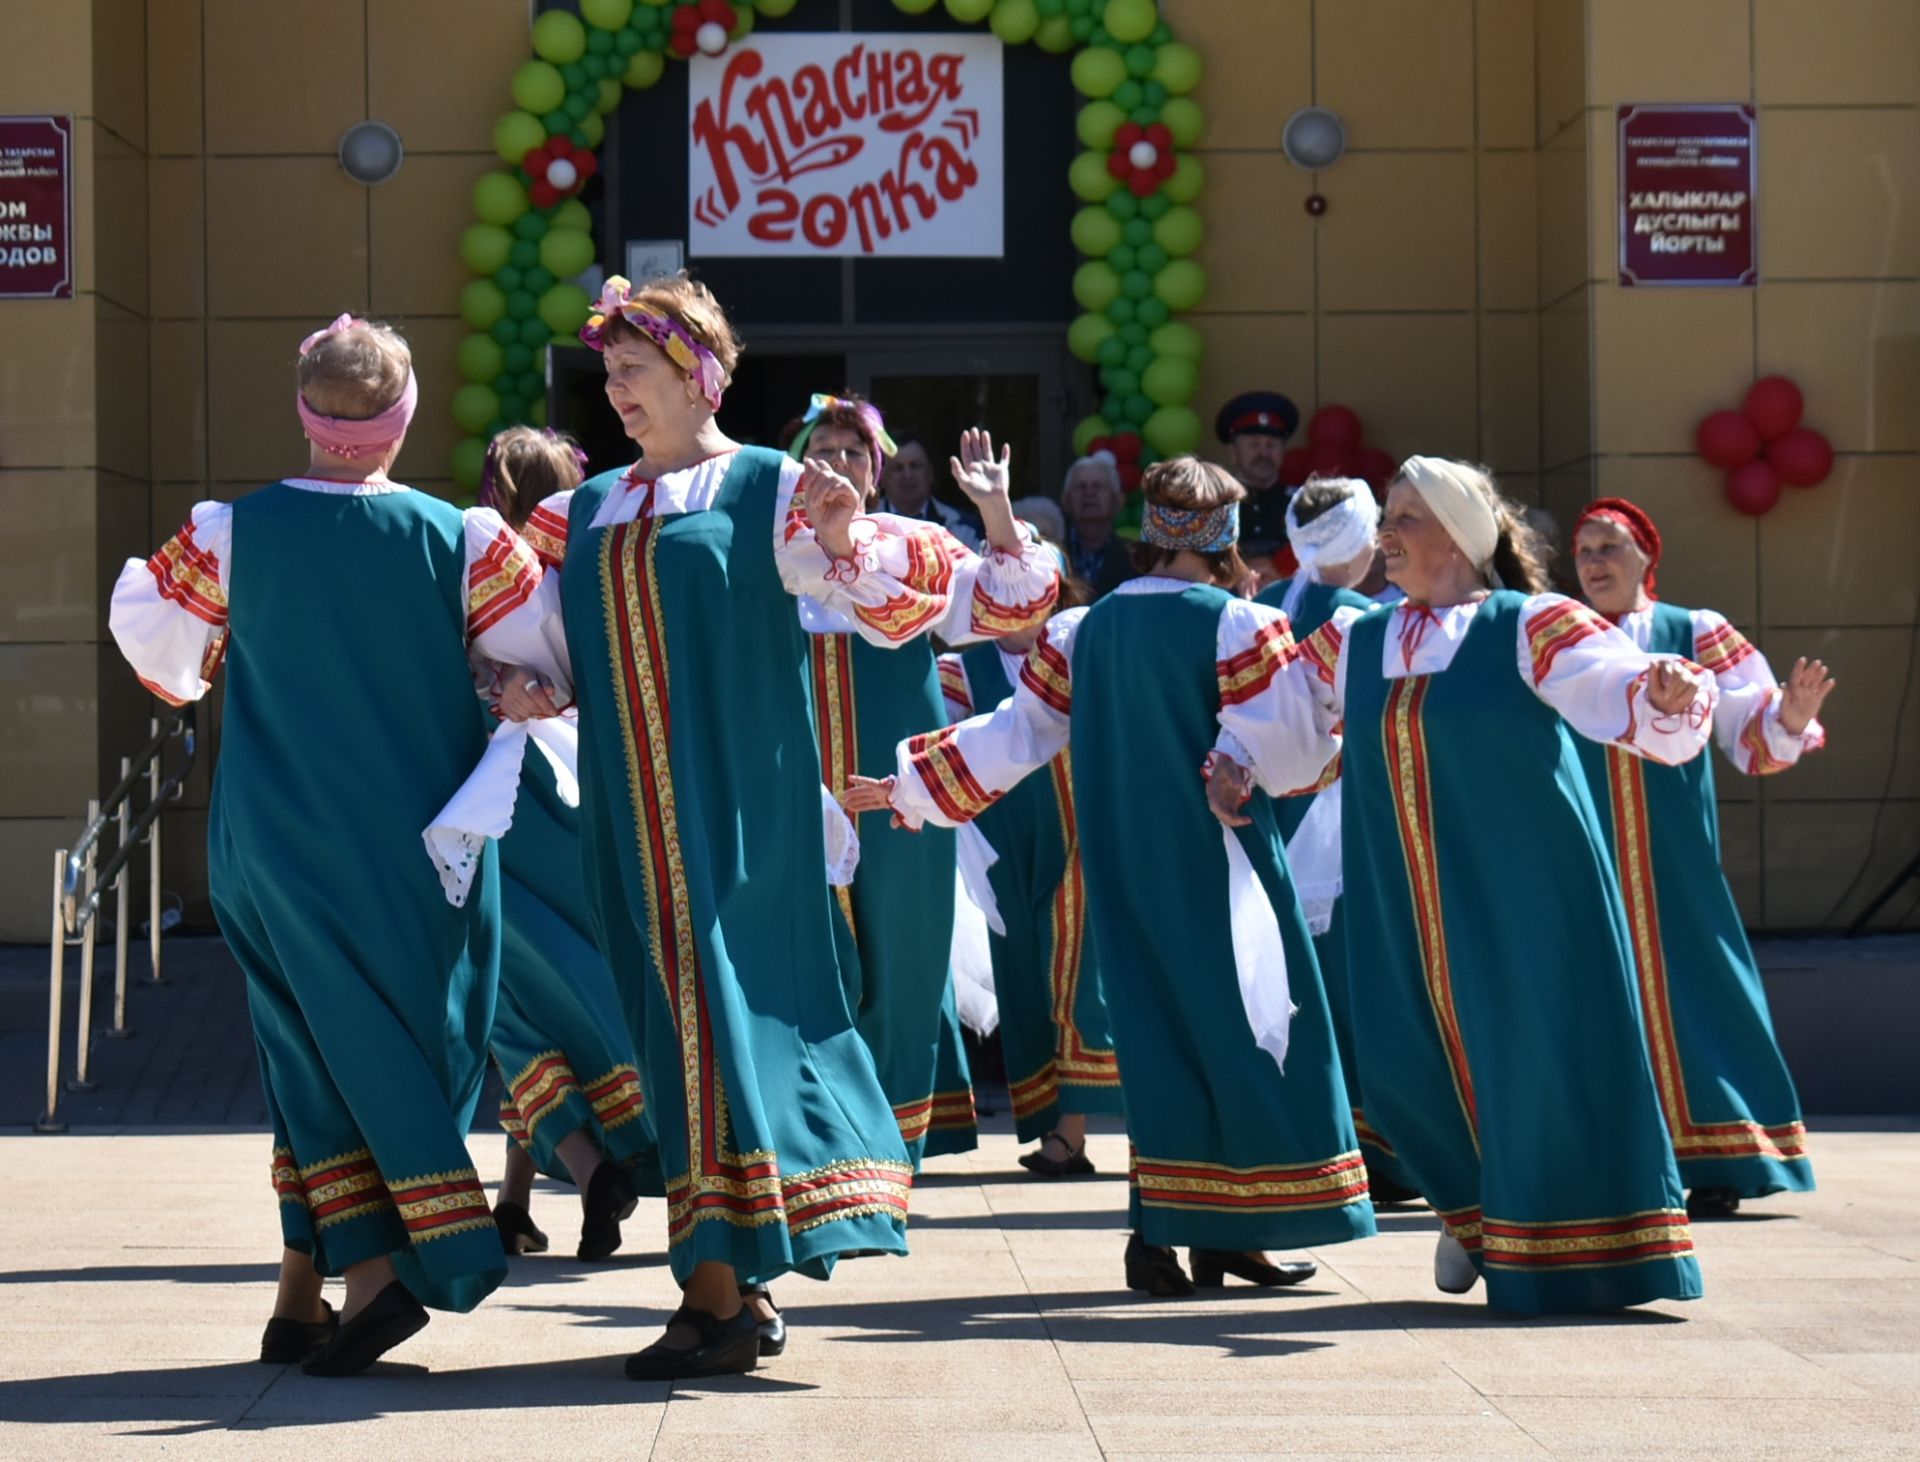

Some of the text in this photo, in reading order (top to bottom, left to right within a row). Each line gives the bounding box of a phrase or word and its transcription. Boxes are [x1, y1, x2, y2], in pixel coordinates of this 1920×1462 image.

[692, 43, 966, 214] Красная
[1630, 191, 1747, 209] ХАЛЫКЛАР
[1634, 213, 1741, 234] ДУСЛЫГЫ
[1650, 232, 1726, 253] ЙОРТЫ
